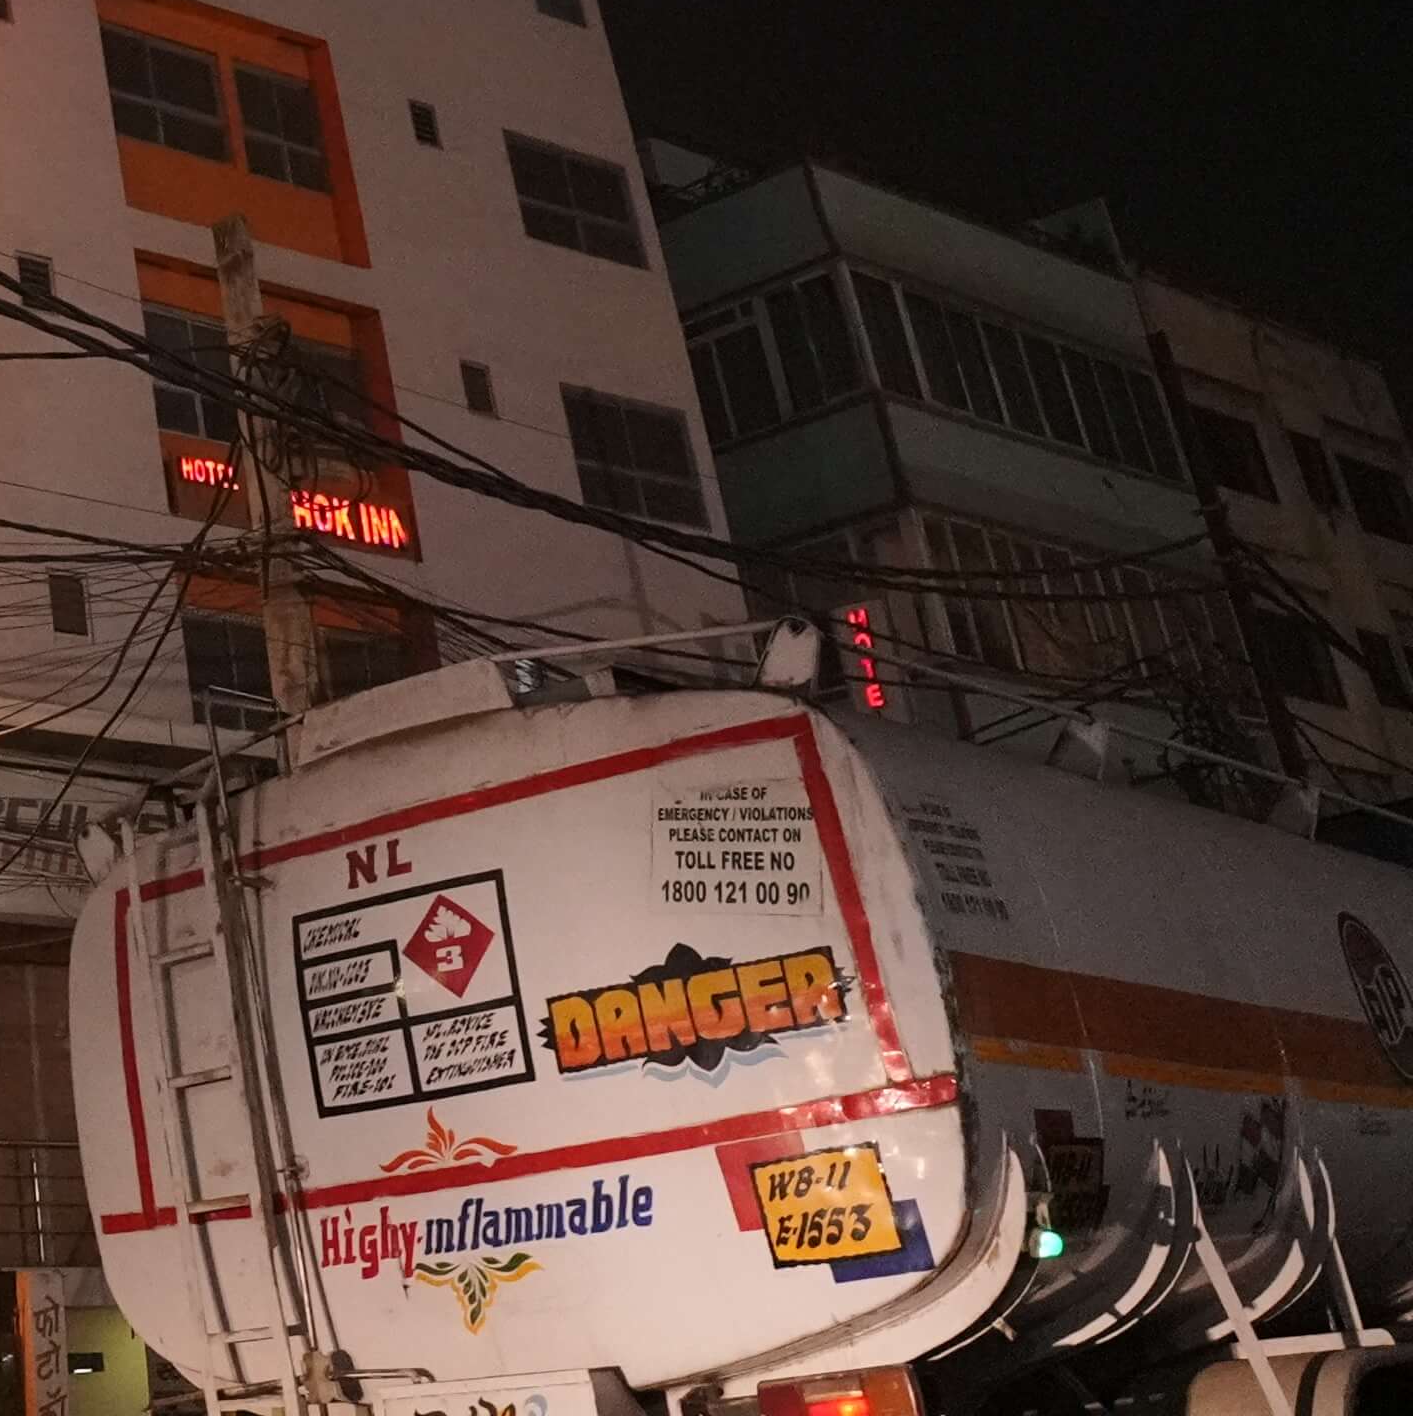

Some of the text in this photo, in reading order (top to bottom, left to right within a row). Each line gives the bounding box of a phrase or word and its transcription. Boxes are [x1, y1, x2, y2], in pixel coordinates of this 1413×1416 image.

[290, 489, 409, 549] HOK INN
[751, 787, 767, 800] OF
[658, 808, 729, 822] EMERGENCY
[740, 807, 814, 822] VIOLATIONS
[669, 828, 801, 842] PLEASE CONTACT ON
[675, 851, 795, 870] TOLL FREE NO
[662, 880, 810, 905] 1800 121 00 90
[435, 945, 464, 972] 3
[550, 951, 845, 1071] DANGER
